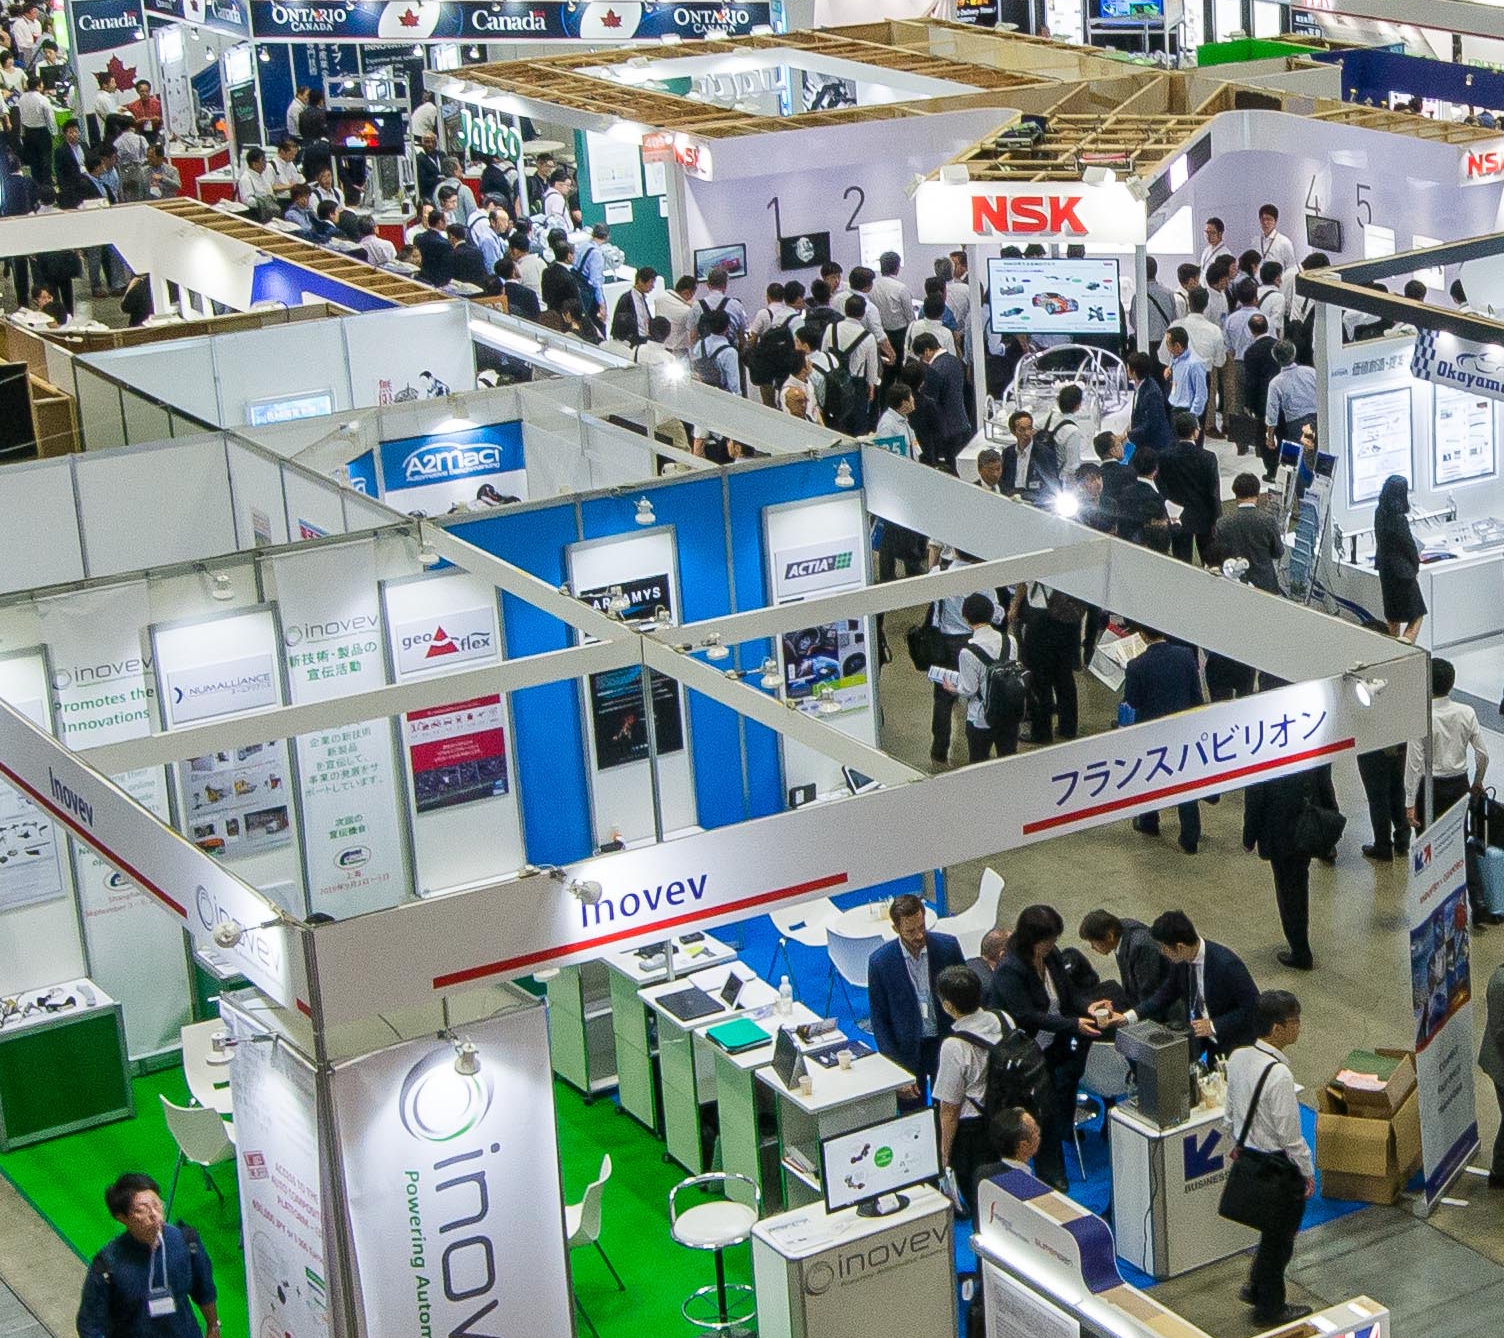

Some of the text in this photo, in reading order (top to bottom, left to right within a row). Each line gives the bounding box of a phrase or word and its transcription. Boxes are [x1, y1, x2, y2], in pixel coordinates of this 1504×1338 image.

[79, 12, 138, 31] Canada
[272, 6, 346, 25] ONTARIO
[291, 19, 337, 32] CANADA
[472, 10, 546, 31] Canada
[674, 8, 749, 26] ONTARIO
[459, 108, 521, 161] Jatco
[843, 187, 866, 230] 2
[971, 195, 1088, 234] NSK
[1356, 184, 1372, 228] 5
[788, 559, 830, 577] ACTIA
[593, 586, 662, 611] ARAMYS
[305, 615, 379, 640] inovev
[401, 633, 490, 652] geo flex
[74, 657, 154, 682] inovev
[306, 660, 362, 683] 宣伝活動
[53, 684, 155, 717] Promotes the
[60, 709, 151, 735] Innovations
[1051, 709, 1328, 807] フランスパビリオン
[48, 766, 95, 829] Inovev
[403, 1169, 426, 1270] Powering
[837, 1223, 950, 1279] inovev
